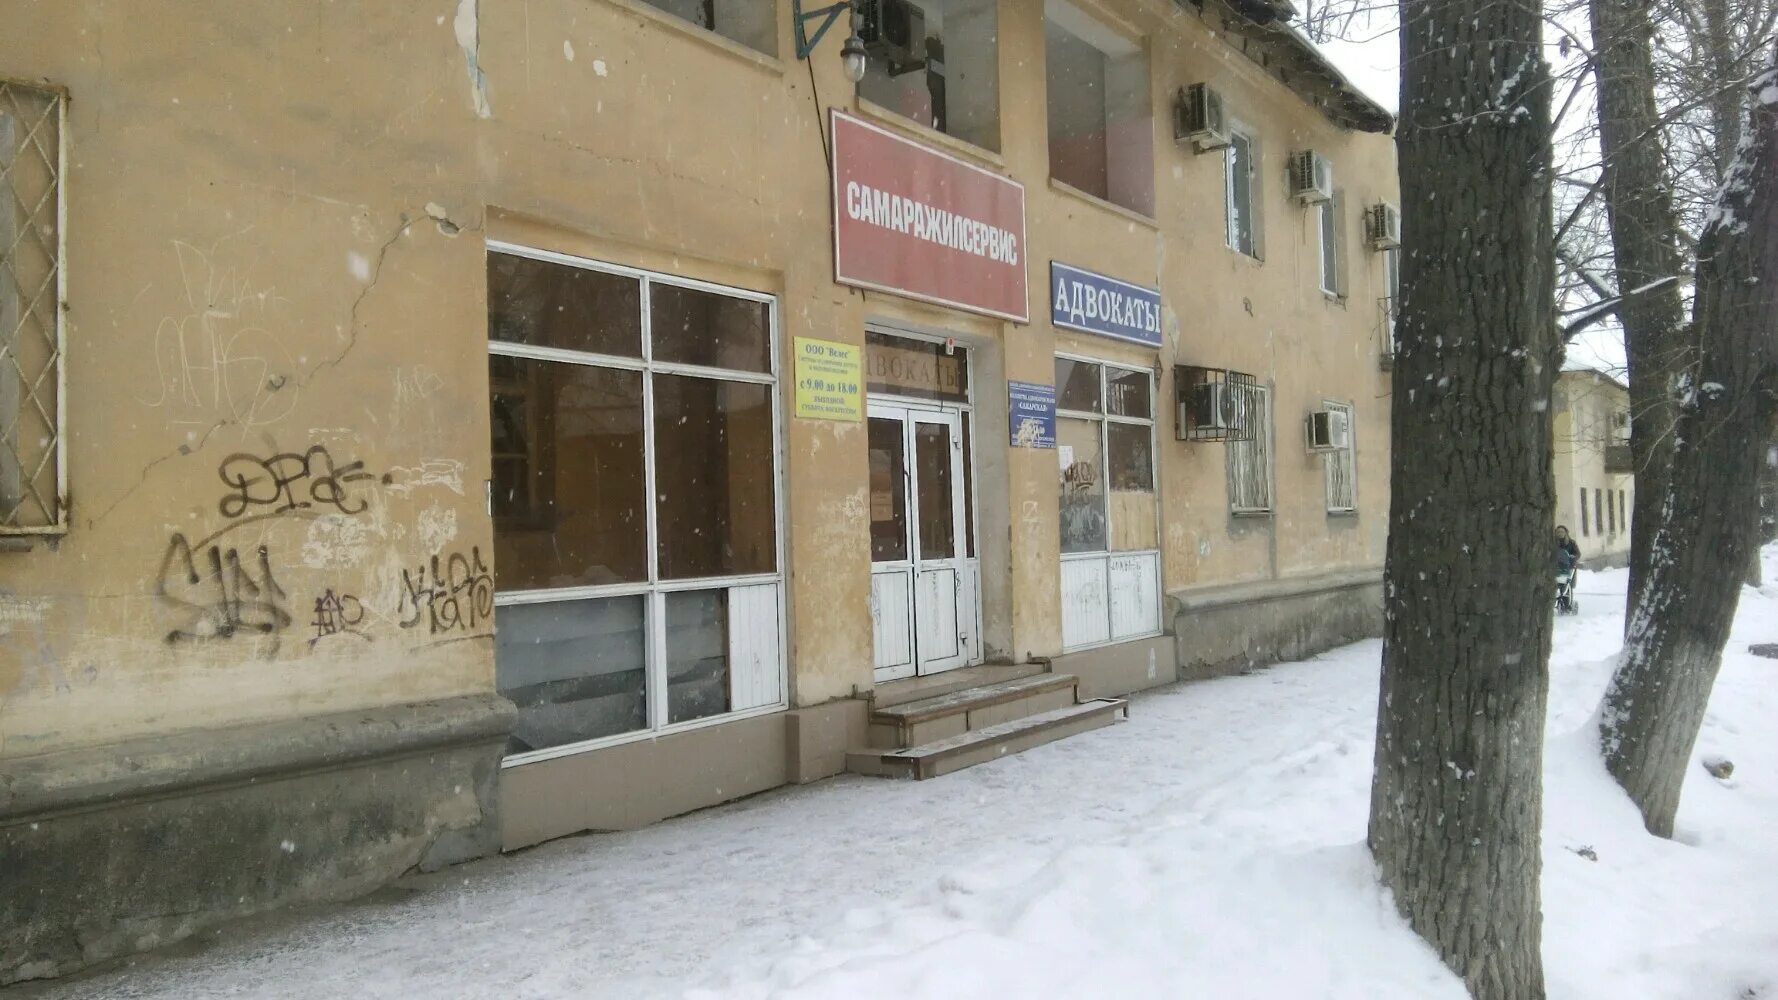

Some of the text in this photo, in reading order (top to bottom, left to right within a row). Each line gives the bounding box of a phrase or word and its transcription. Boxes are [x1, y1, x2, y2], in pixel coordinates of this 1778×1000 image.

[847, 180, 1018, 266] САМАРАЖИЛСЕРВИС
[1055, 277, 1161, 334] АДВОКАТЫ
[805, 344, 824, 355] ООО
